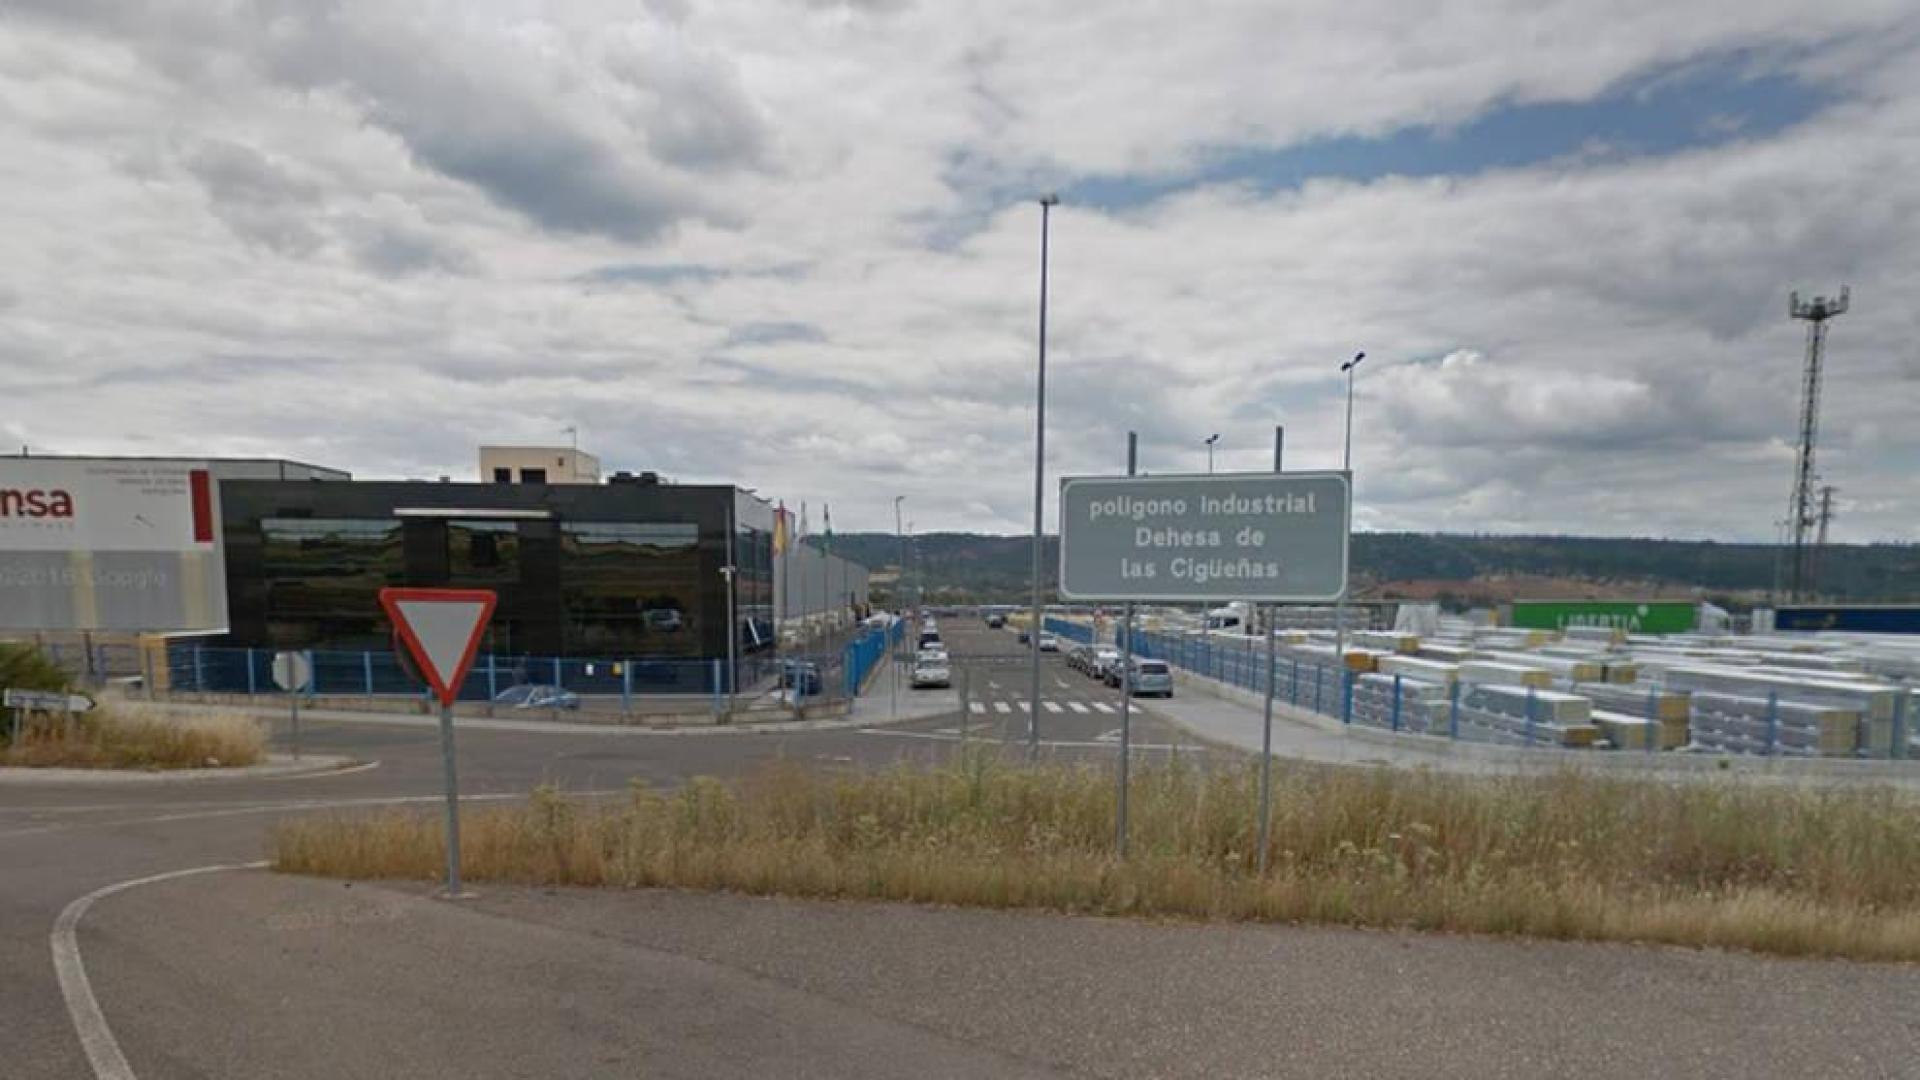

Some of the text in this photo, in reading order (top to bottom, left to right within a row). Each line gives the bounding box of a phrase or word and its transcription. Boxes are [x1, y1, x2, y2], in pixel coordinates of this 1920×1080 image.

[1200, 492, 1316, 514] industrial
[1135, 526, 1265, 547] Dehesa de
[1121, 557, 1279, 582] las Cigüeñas
